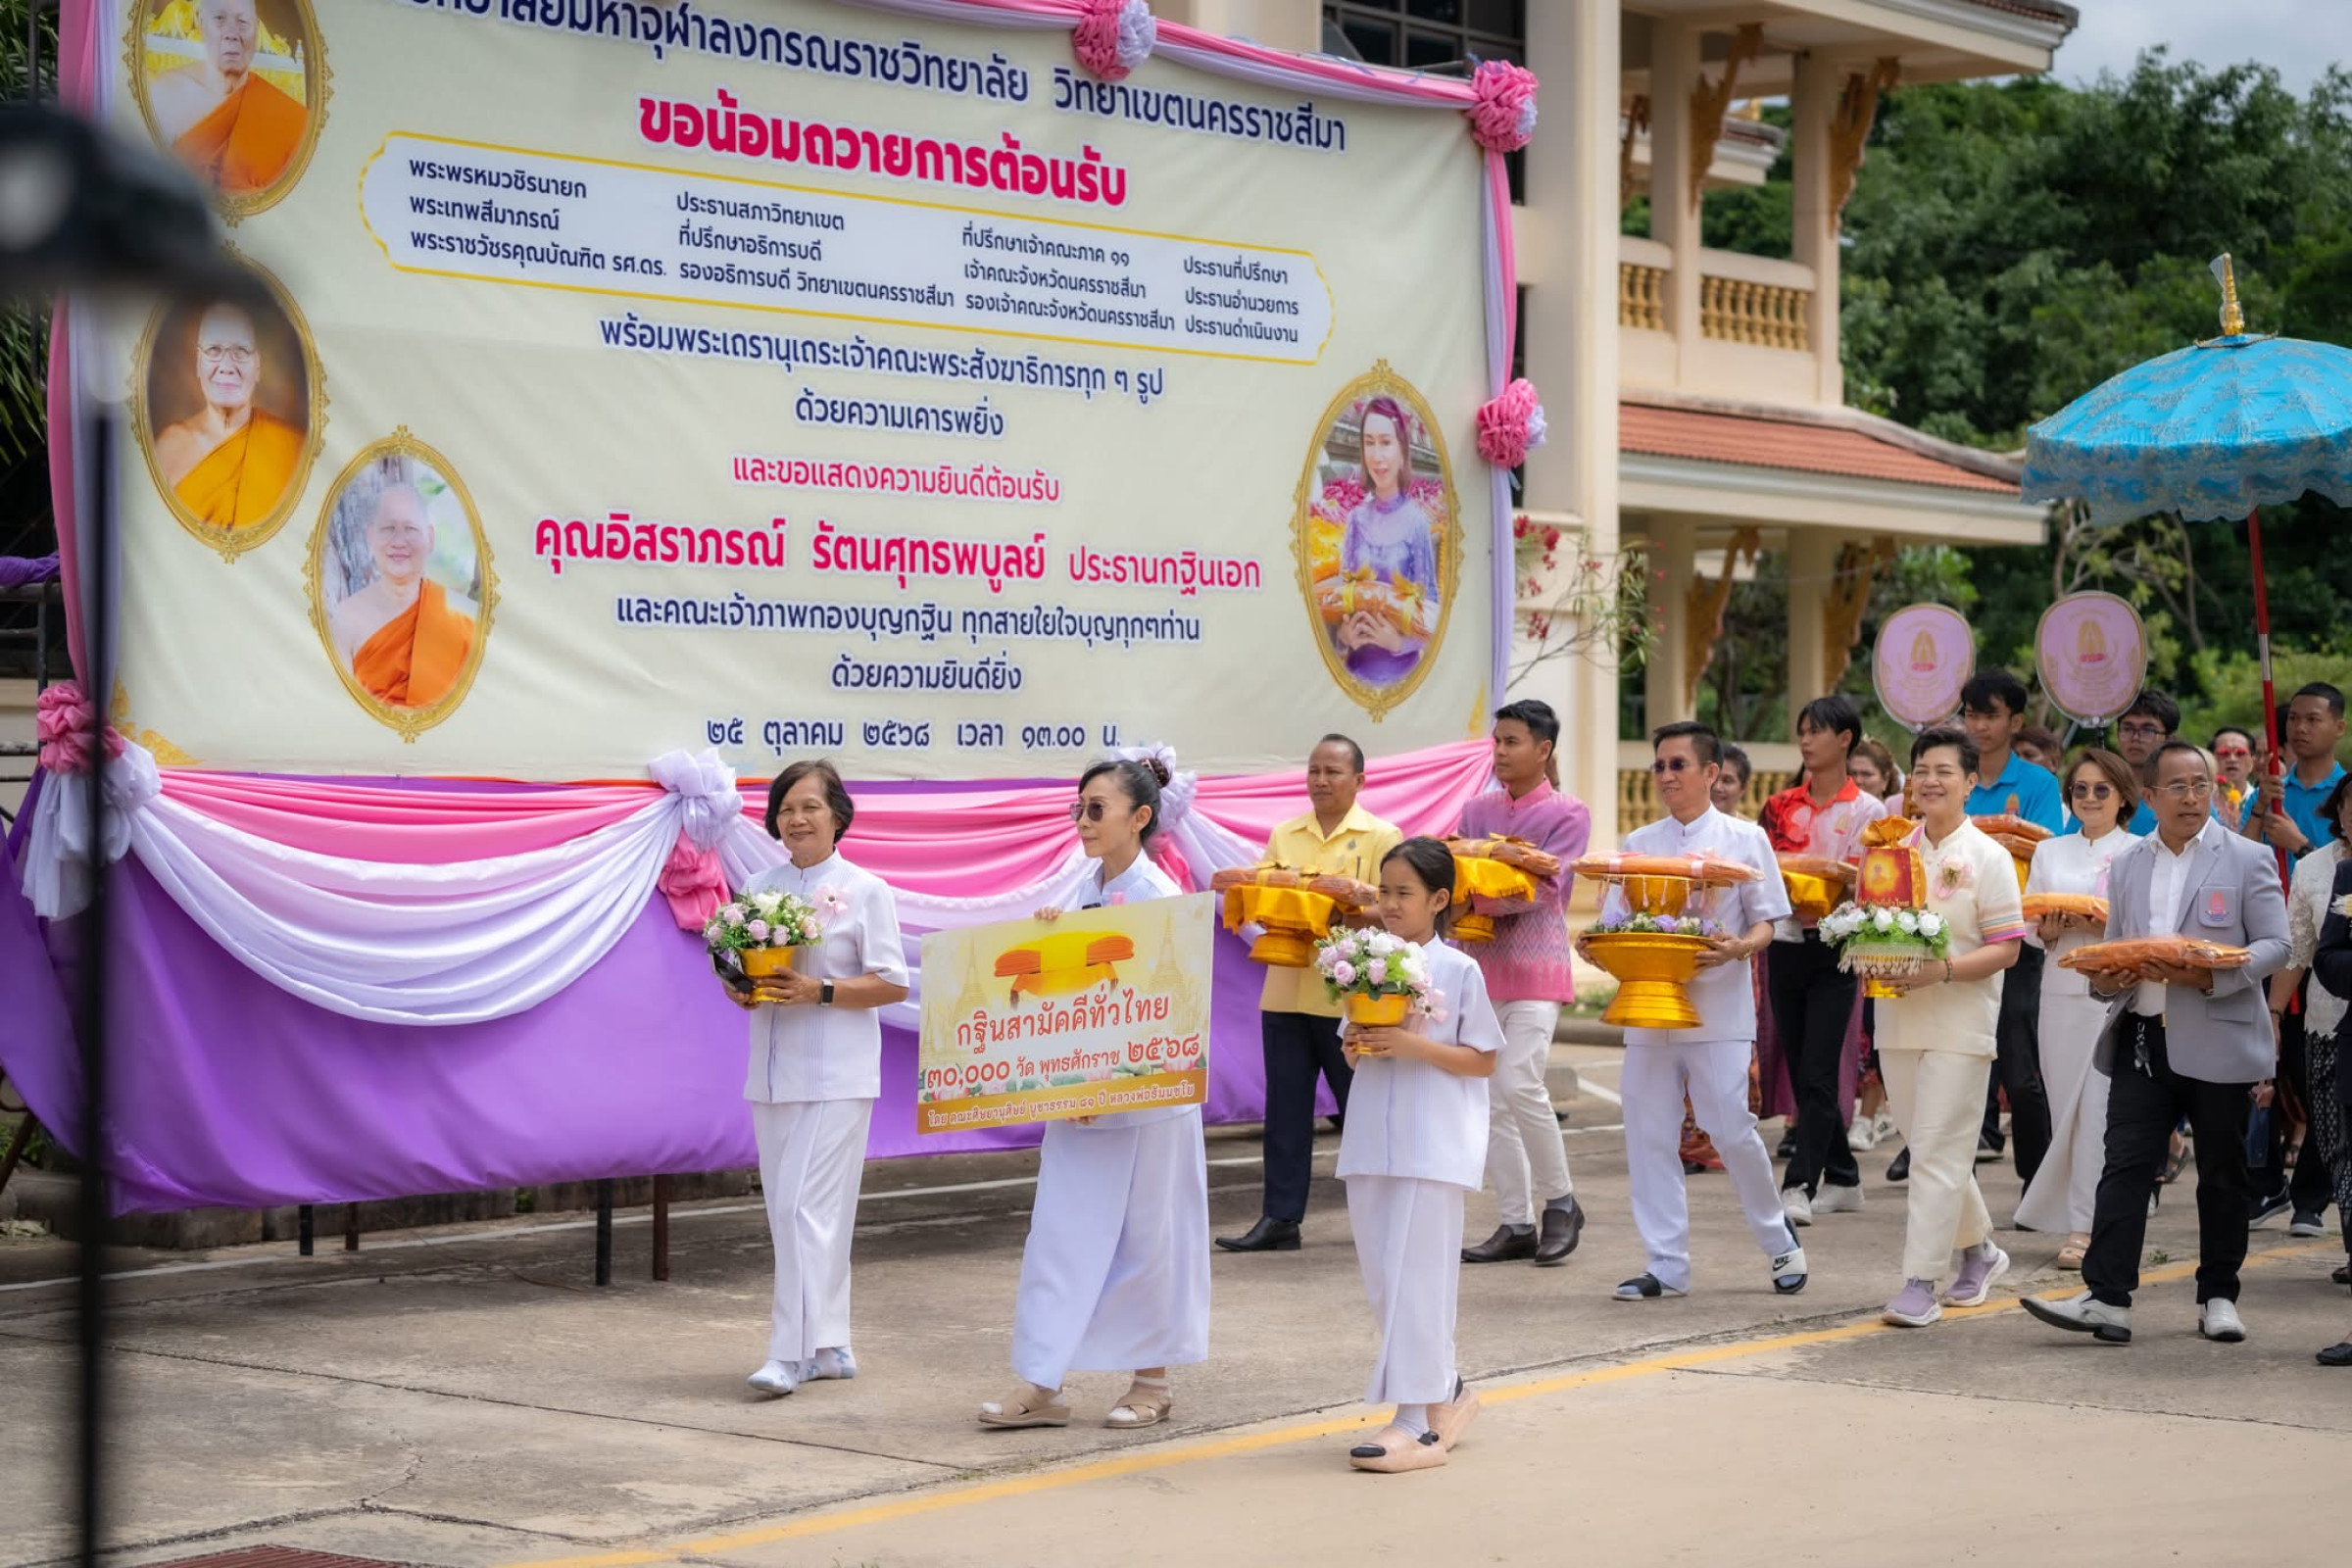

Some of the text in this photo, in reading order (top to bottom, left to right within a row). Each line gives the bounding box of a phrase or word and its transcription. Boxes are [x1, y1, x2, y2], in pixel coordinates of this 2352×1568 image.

[1054, 67, 1345, 150] วิทยาเขตนครราชสีมา
[640, 89, 1125, 205] ขอน้อมถวายการต้อนรับ
[410, 160, 1287, 283] พระพรหมวชิรนายก ประธานสภาวิทยาเขต ที่ปรึกษาเจ้าคณะภาค ๑๑ ประธานที่ปรึกษา
[410, 196, 1298, 315] พระเทพสีมาภรณ์ ที่ปรึกษาอธิการบดี เจ้าคณะจังหวัดนครราชสีมา ประธานอำนวยการ
[411, 231, 1298, 342] พระราชวัชรคุณบัณฑิต รศ.ดร. รองอธิการบดี วิทยาเขตนครราชสีมา รองเจ้าคณะจังหวัดนครราชสีมา ประธานดำเนินงาน
[797, 388, 1003, 435] ด้วยความเคารพยิ่ง
[1138, 368, 1162, 404] รูป
[735, 459, 1058, 500] และขอแสดงความยินดีต้อนรับ
[536, 514, 1259, 594] คุณอิสราภรณ์ รัตนศุทธพบูลย์ ประธานกฐินเอก
[618, 593, 1200, 647] และคณะเจ้าภาพกองบุญกฐิน ทุกสายใยใจบุญทุกๆท่าน
[833, 651, 1021, 689] ด้วยความยินดียิ่ง
[708, 718, 1120, 756] ๒๕ ตุลาคม ๒๕๖๘ เวลา ๑๓.๐๐ น.
[957, 984, 1169, 1054] กฐินสามัคคีทั่วไทย
[1016, 1056, 1035, 1077] วัด
[1040, 1048, 1120, 1082] พุทธศักราช
[1127, 1032, 1200, 1063] ๒๕๖๘
[928, 1109, 948, 1126] โดย
